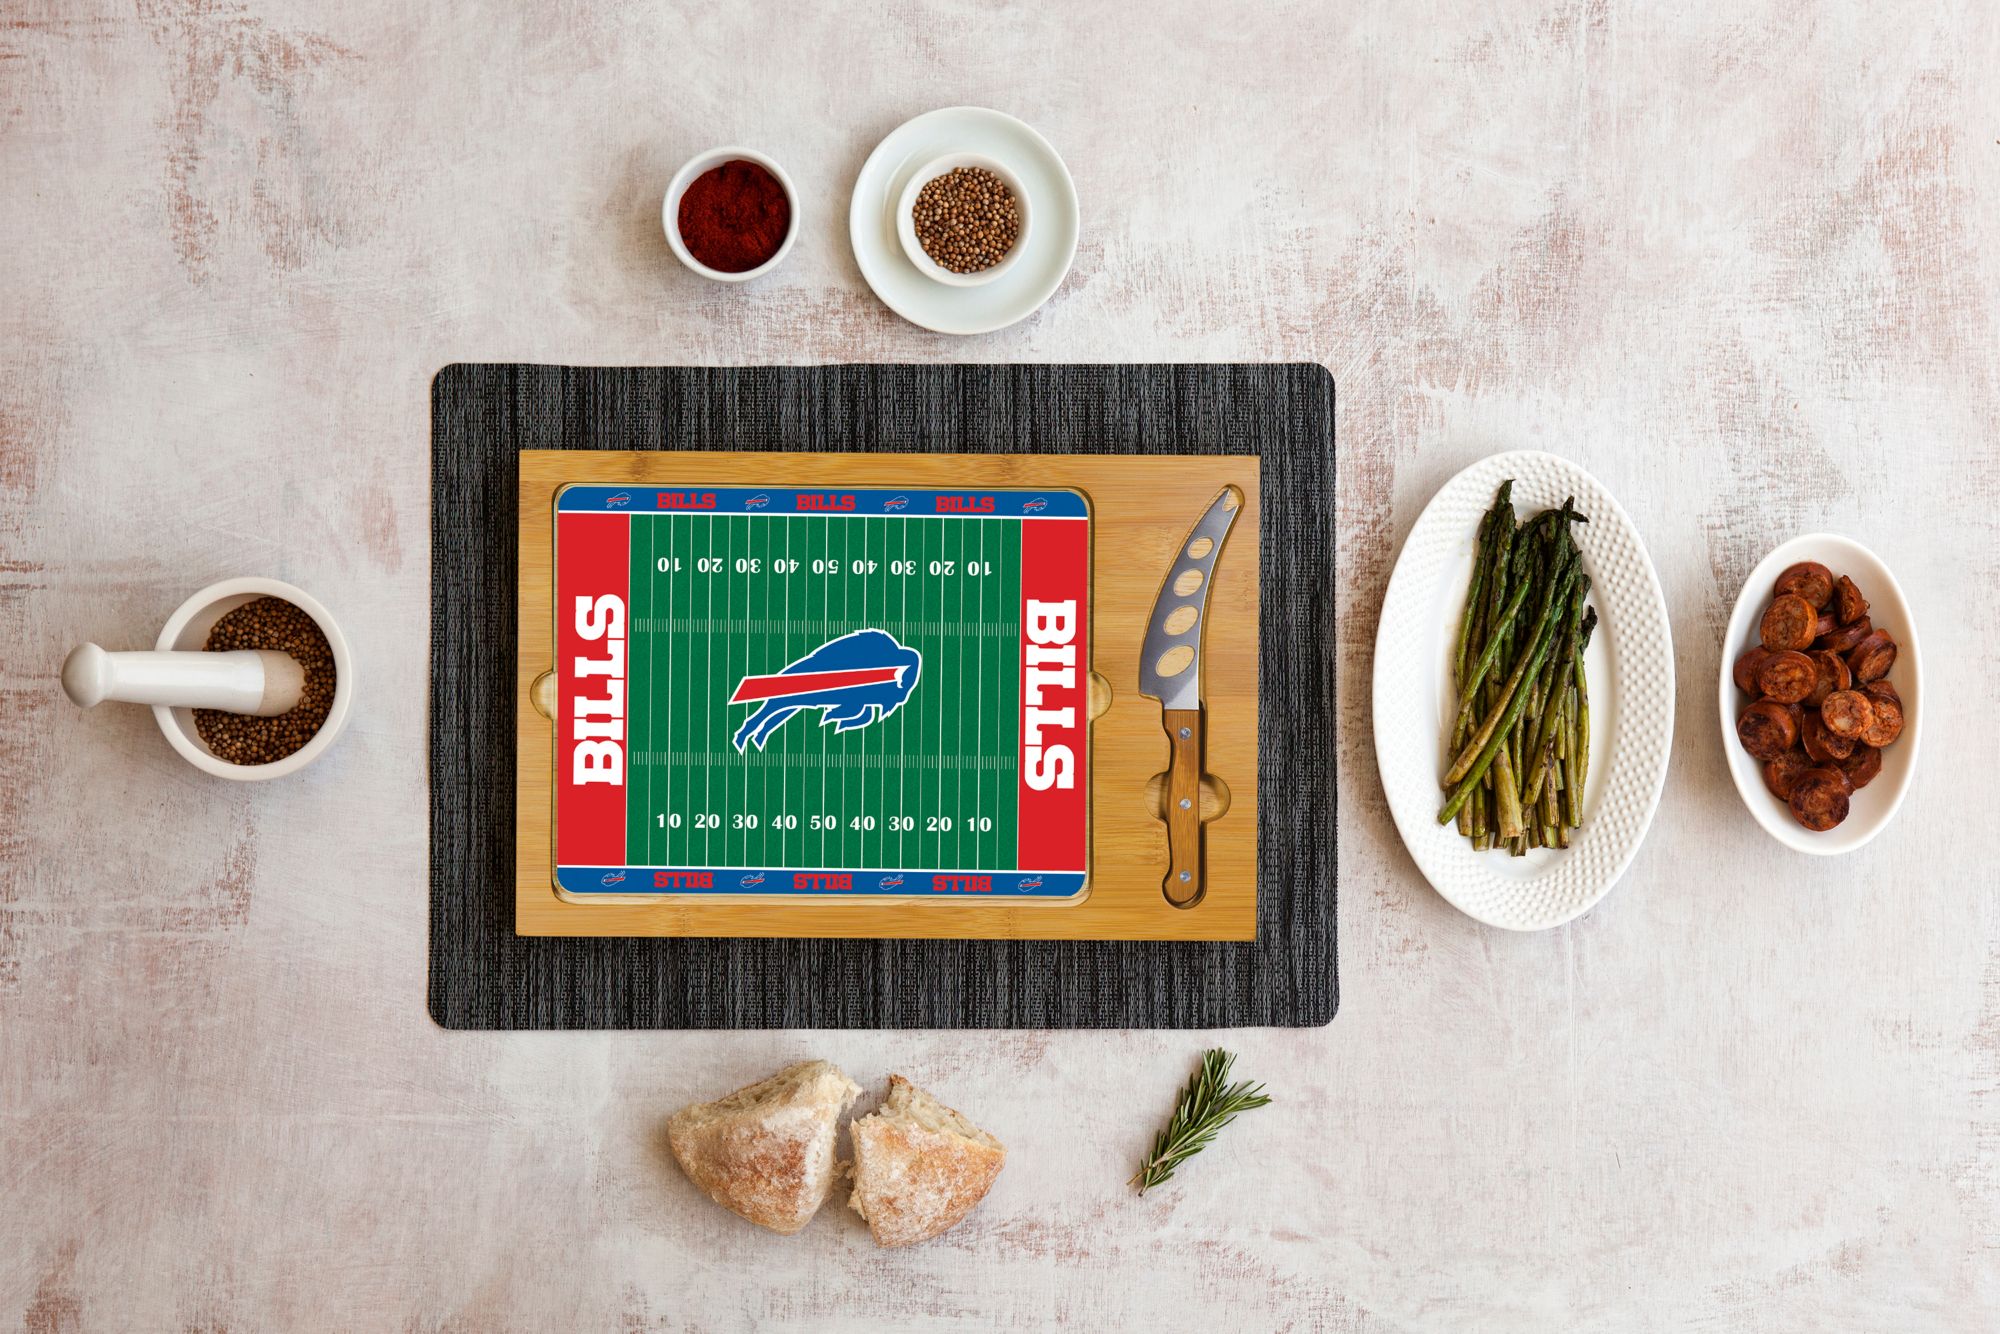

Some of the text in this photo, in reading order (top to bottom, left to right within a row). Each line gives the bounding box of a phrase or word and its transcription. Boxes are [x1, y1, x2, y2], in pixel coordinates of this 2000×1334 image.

[656, 492, 717, 510] BILLS
[796, 494, 856, 511] BILLS
[935, 495, 995, 513] BILLS
[657, 557, 992, 577] 10 20 30 40 50 40 30 20 10
[572, 593, 625, 786] BILLS
[1024, 599, 1077, 791] BILLS
[656, 813, 992, 832] 10 20 30 40 50 40 30 20 10
[653, 871, 714, 889] BILLS
[793, 873, 853, 891] BILLS
[932, 874, 993, 893] BILLS
